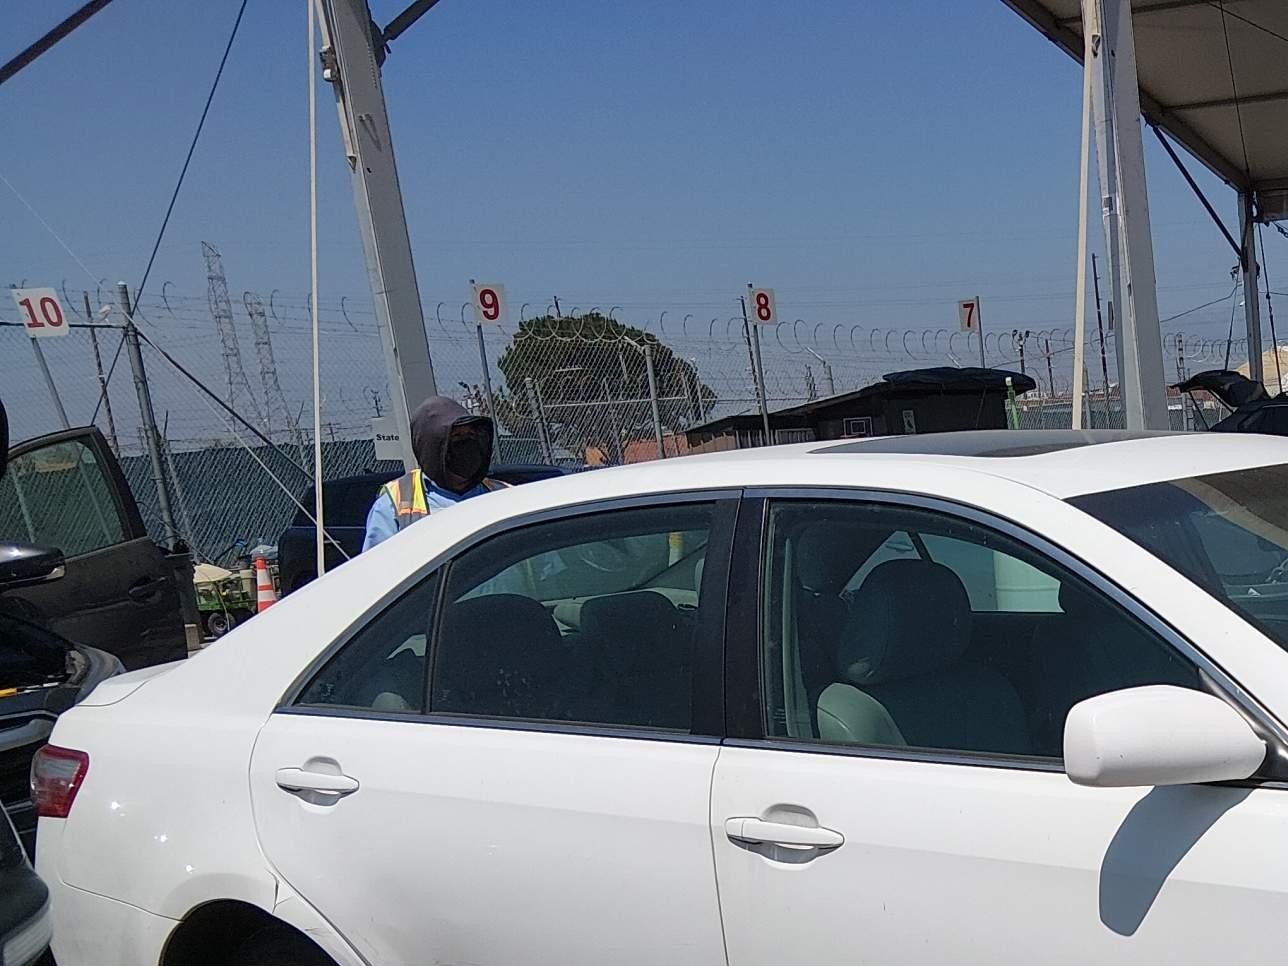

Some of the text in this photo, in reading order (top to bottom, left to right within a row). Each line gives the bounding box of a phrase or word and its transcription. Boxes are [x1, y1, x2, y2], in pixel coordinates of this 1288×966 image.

[19, 297, 63, 328] 10
[479, 288, 500, 321] 9
[756, 292, 772, 321] 8
[962, 302, 975, 328] 7
[375, 433, 400, 441] State
